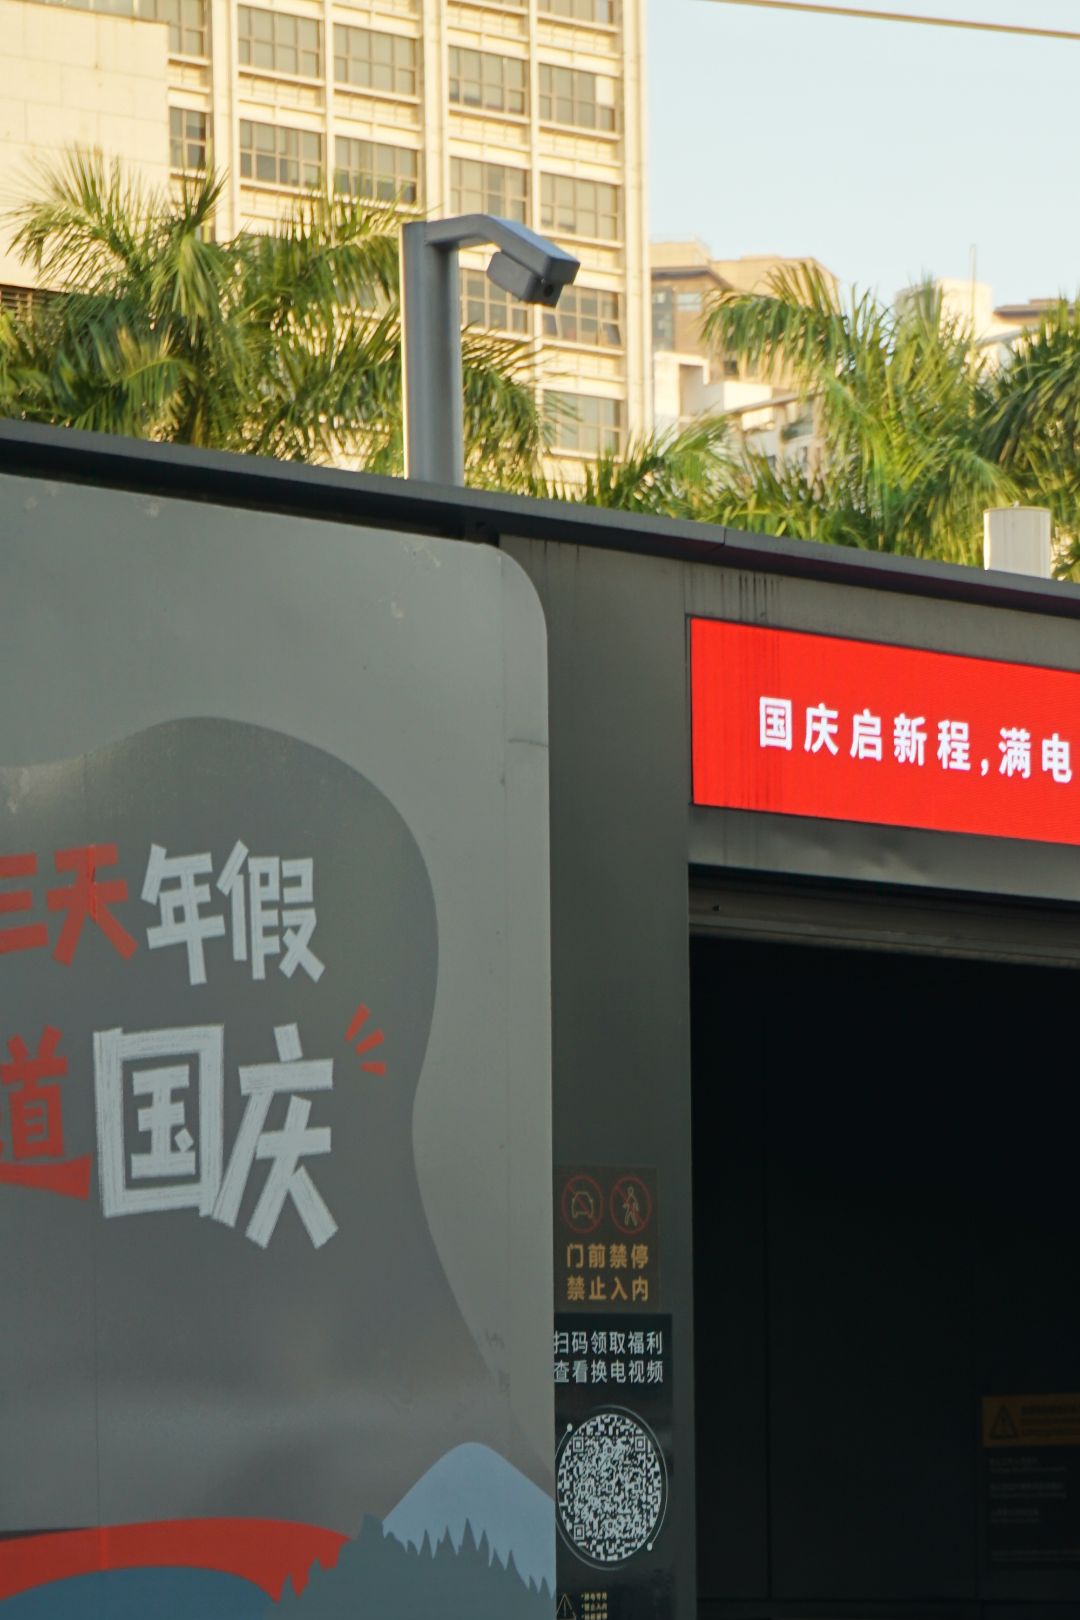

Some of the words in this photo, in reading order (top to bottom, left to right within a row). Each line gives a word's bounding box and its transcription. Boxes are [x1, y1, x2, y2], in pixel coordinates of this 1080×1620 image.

[566, 1243, 649, 1269] 门前禁停
[566, 1275, 649, 1302] 禁止入内
[553, 1330, 663, 1355] 扫码领取福利
[553, 1359, 664, 1384] 查看换电视频
